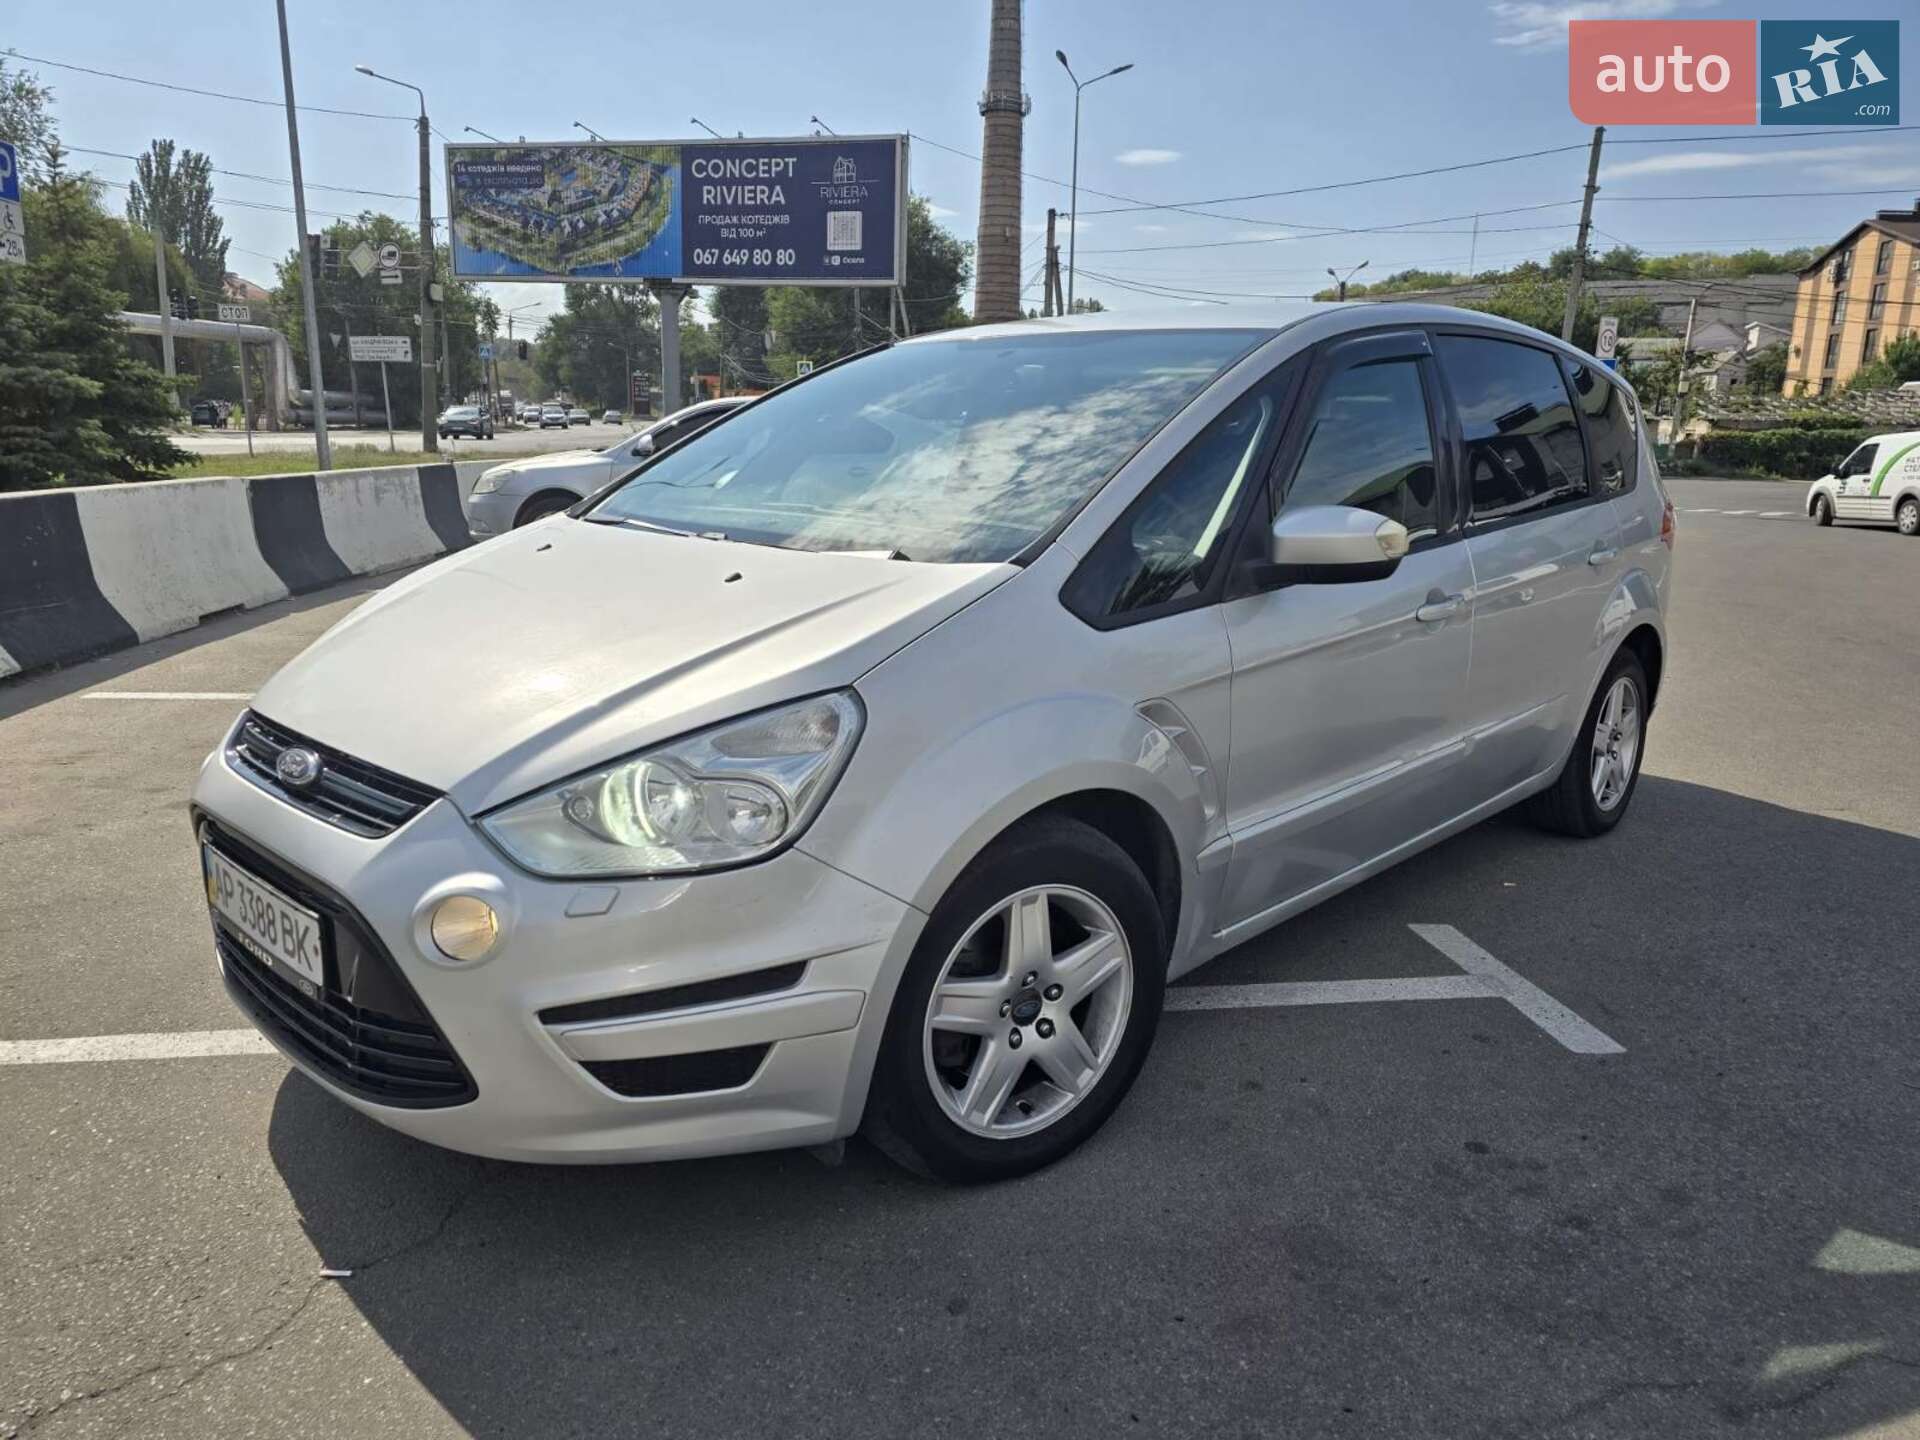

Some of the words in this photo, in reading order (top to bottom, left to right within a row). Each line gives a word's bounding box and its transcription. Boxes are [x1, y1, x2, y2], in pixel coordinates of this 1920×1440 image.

[691, 157, 798, 179] CONCEPT
[702, 184, 786, 206] RIVIERA
[820, 185, 869, 199] RIVIERA
[698, 214, 739, 225] ПРОДАЖ
[741, 214, 790, 226] КОТЕДЖІВ
[720, 227, 737, 239] ВІД
[738, 227, 754, 238] 100
[693, 248, 718, 265] 067
[722, 248, 749, 265] 649
[752, 248, 772, 265] 80
[776, 248, 796, 265] 80
[221, 306, 249, 319] СТОП
[237, 880, 277, 946] 3388
[280, 910, 314, 973] BK
